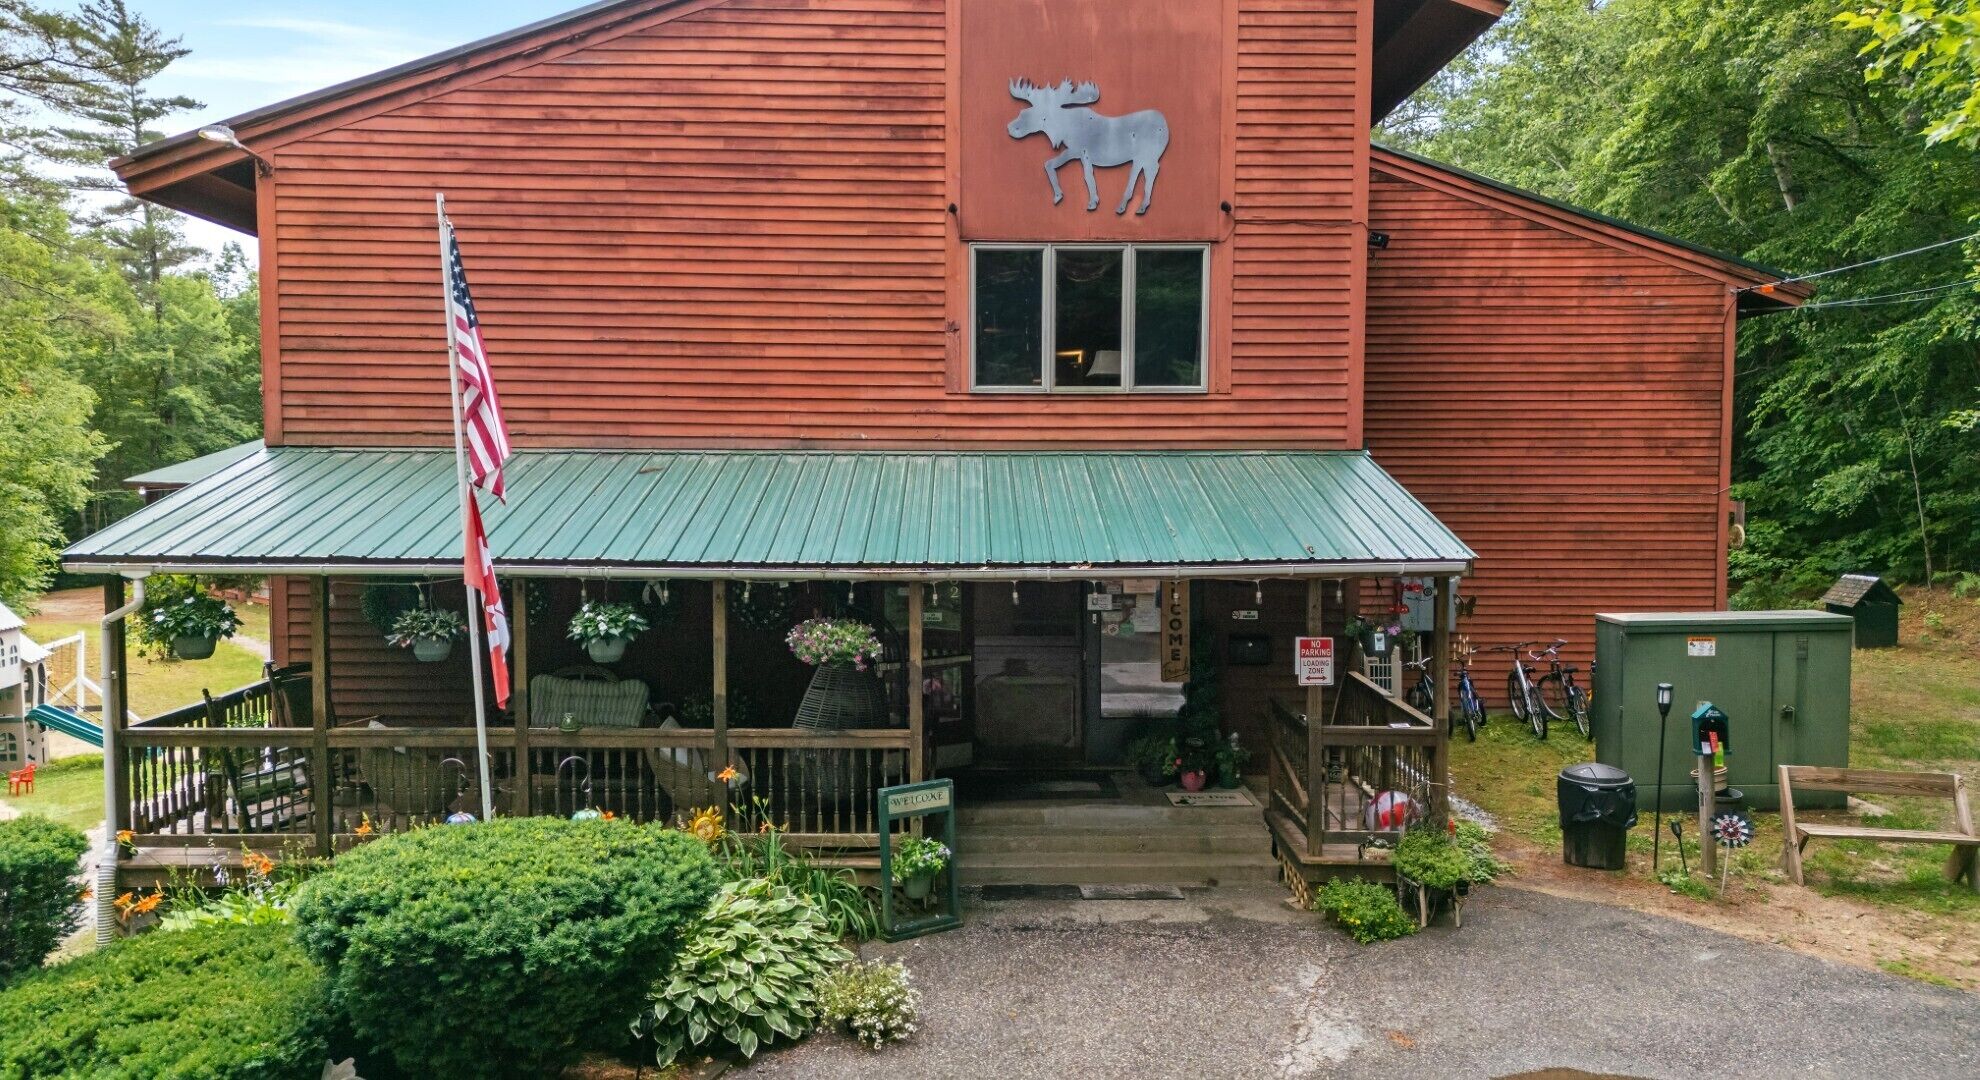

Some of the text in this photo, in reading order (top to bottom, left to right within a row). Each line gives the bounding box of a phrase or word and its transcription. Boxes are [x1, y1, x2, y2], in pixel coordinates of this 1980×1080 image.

[1311, 640, 1321, 648] NO
[1301, 648, 1331, 656] PARKING
[1308, 667, 1325, 675] ZONE
[890, 791, 944, 806] WELCOME
